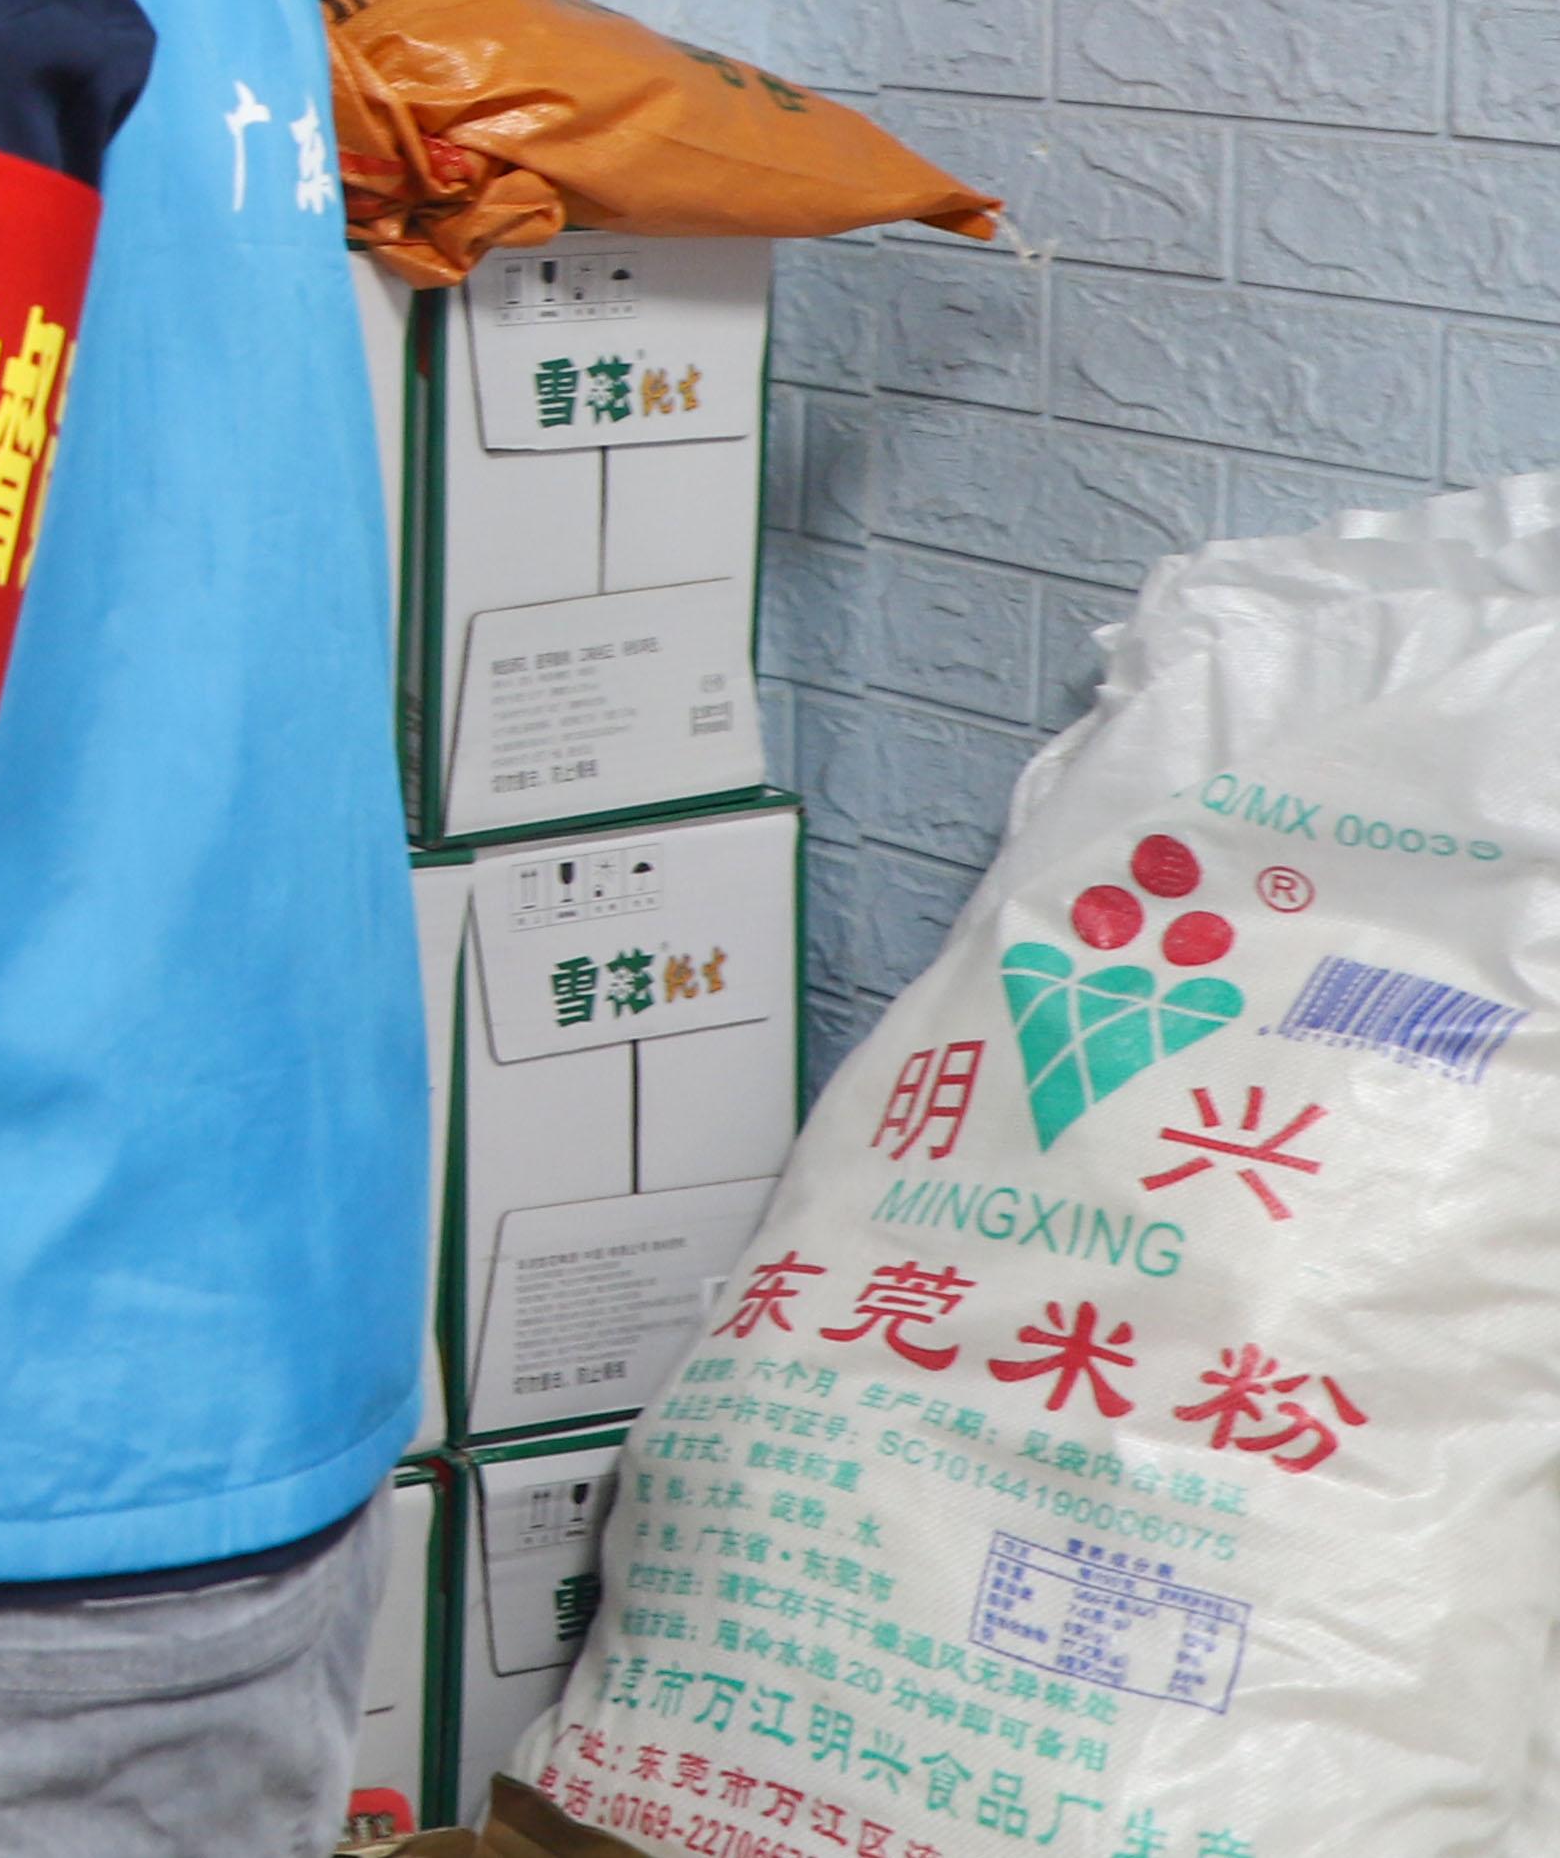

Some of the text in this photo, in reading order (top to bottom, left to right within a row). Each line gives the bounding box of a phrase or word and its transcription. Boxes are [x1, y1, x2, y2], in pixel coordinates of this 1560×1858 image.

[870, 1178, 1187, 1279] MINGXING
[711, 1250, 1370, 1475] 东莞米粉
